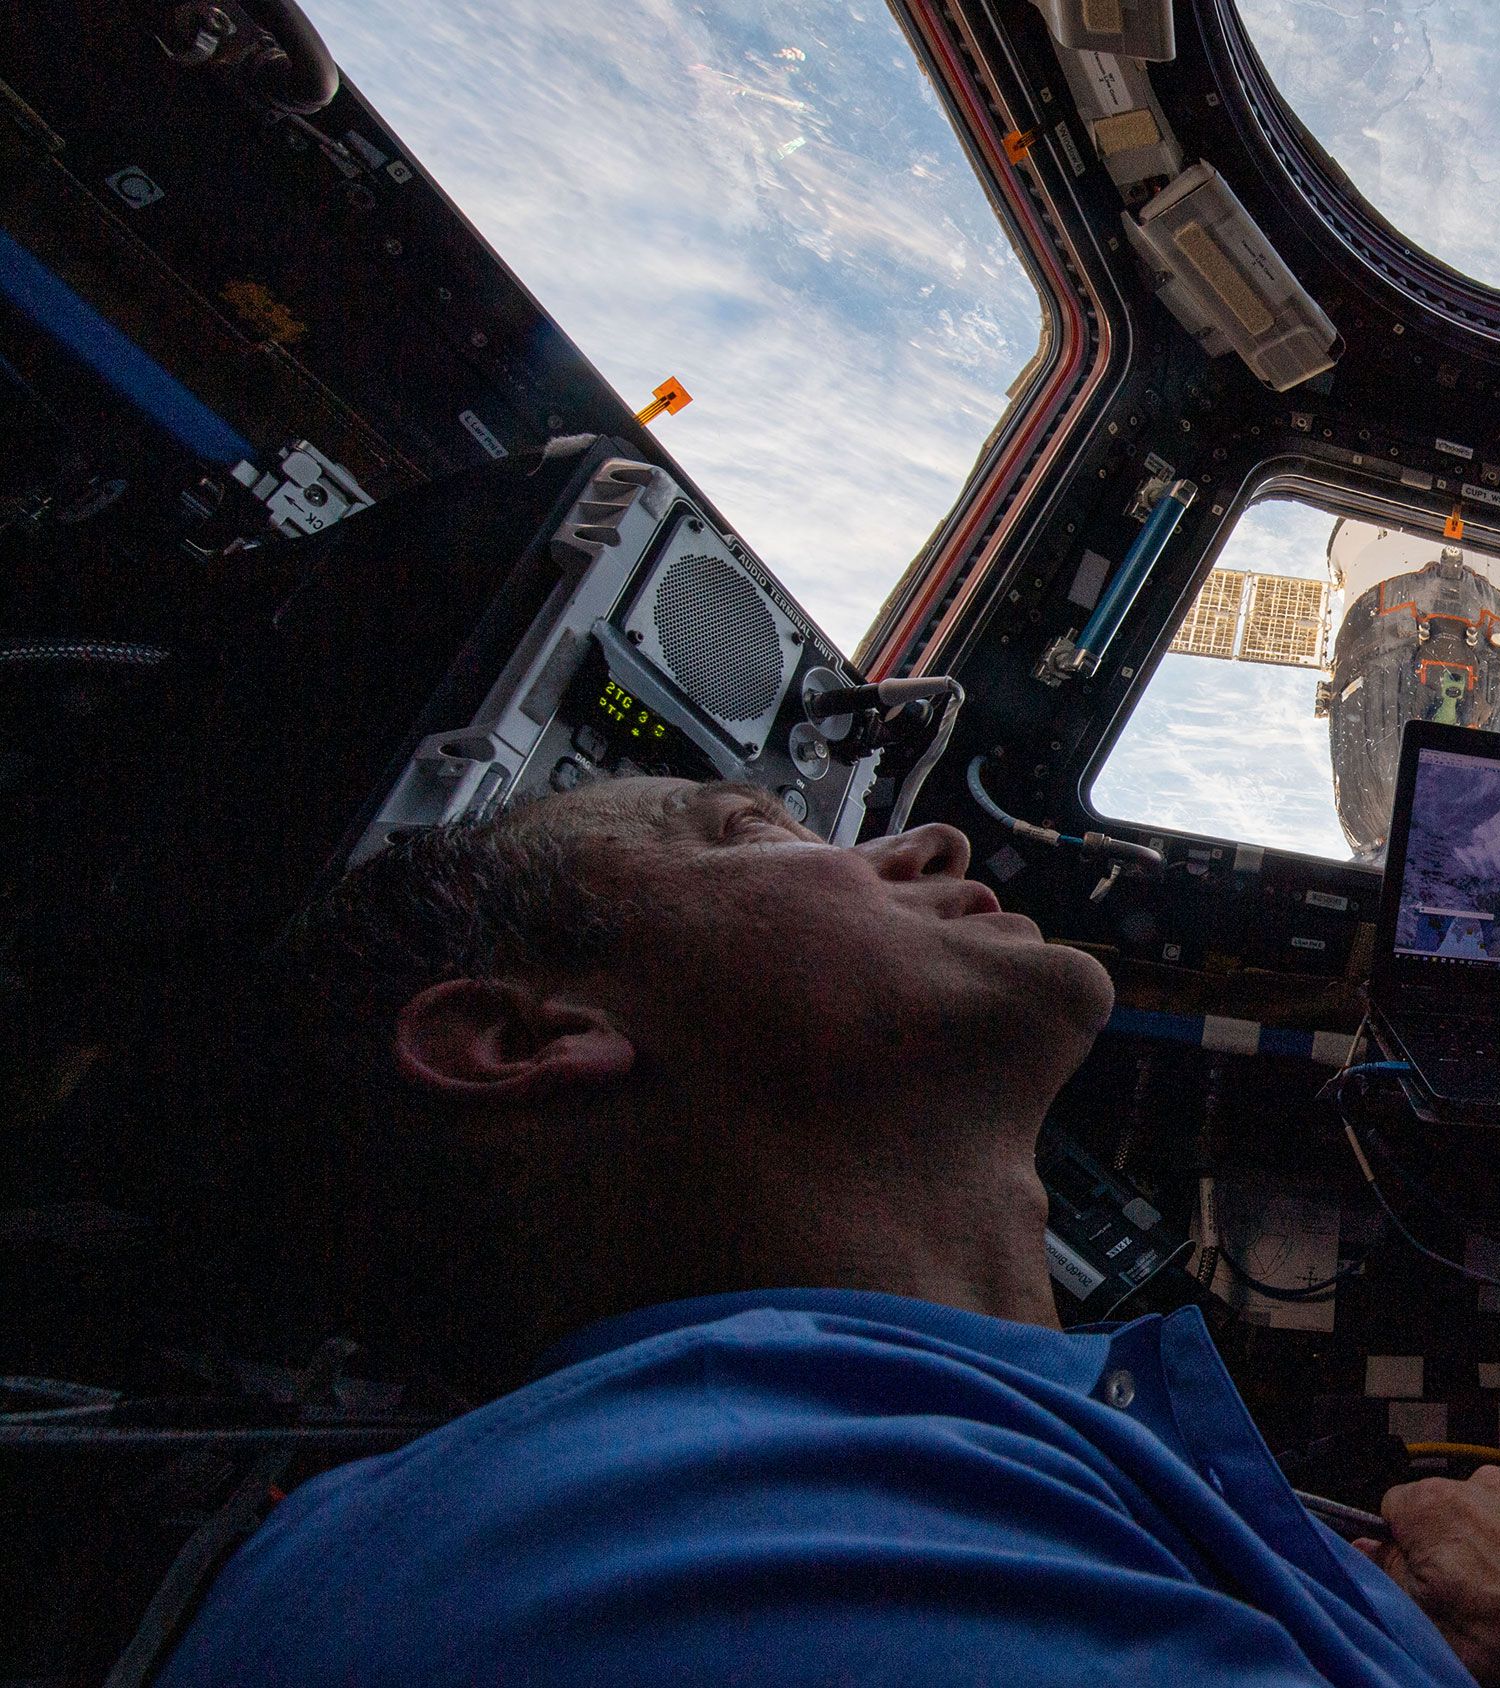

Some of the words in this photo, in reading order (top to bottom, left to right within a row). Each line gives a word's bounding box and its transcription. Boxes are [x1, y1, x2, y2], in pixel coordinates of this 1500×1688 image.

[305, 512, 324, 530] CK
[737, 554, 767, 588] AUDIO
[769, 586, 812, 639] TERMINAL
[813, 638, 835, 661] UNIT
[786, 794, 805, 815] PTT
[1046, 1243, 1066, 1266] Binoc
[1065, 1264, 1093, 1287] 20x60
